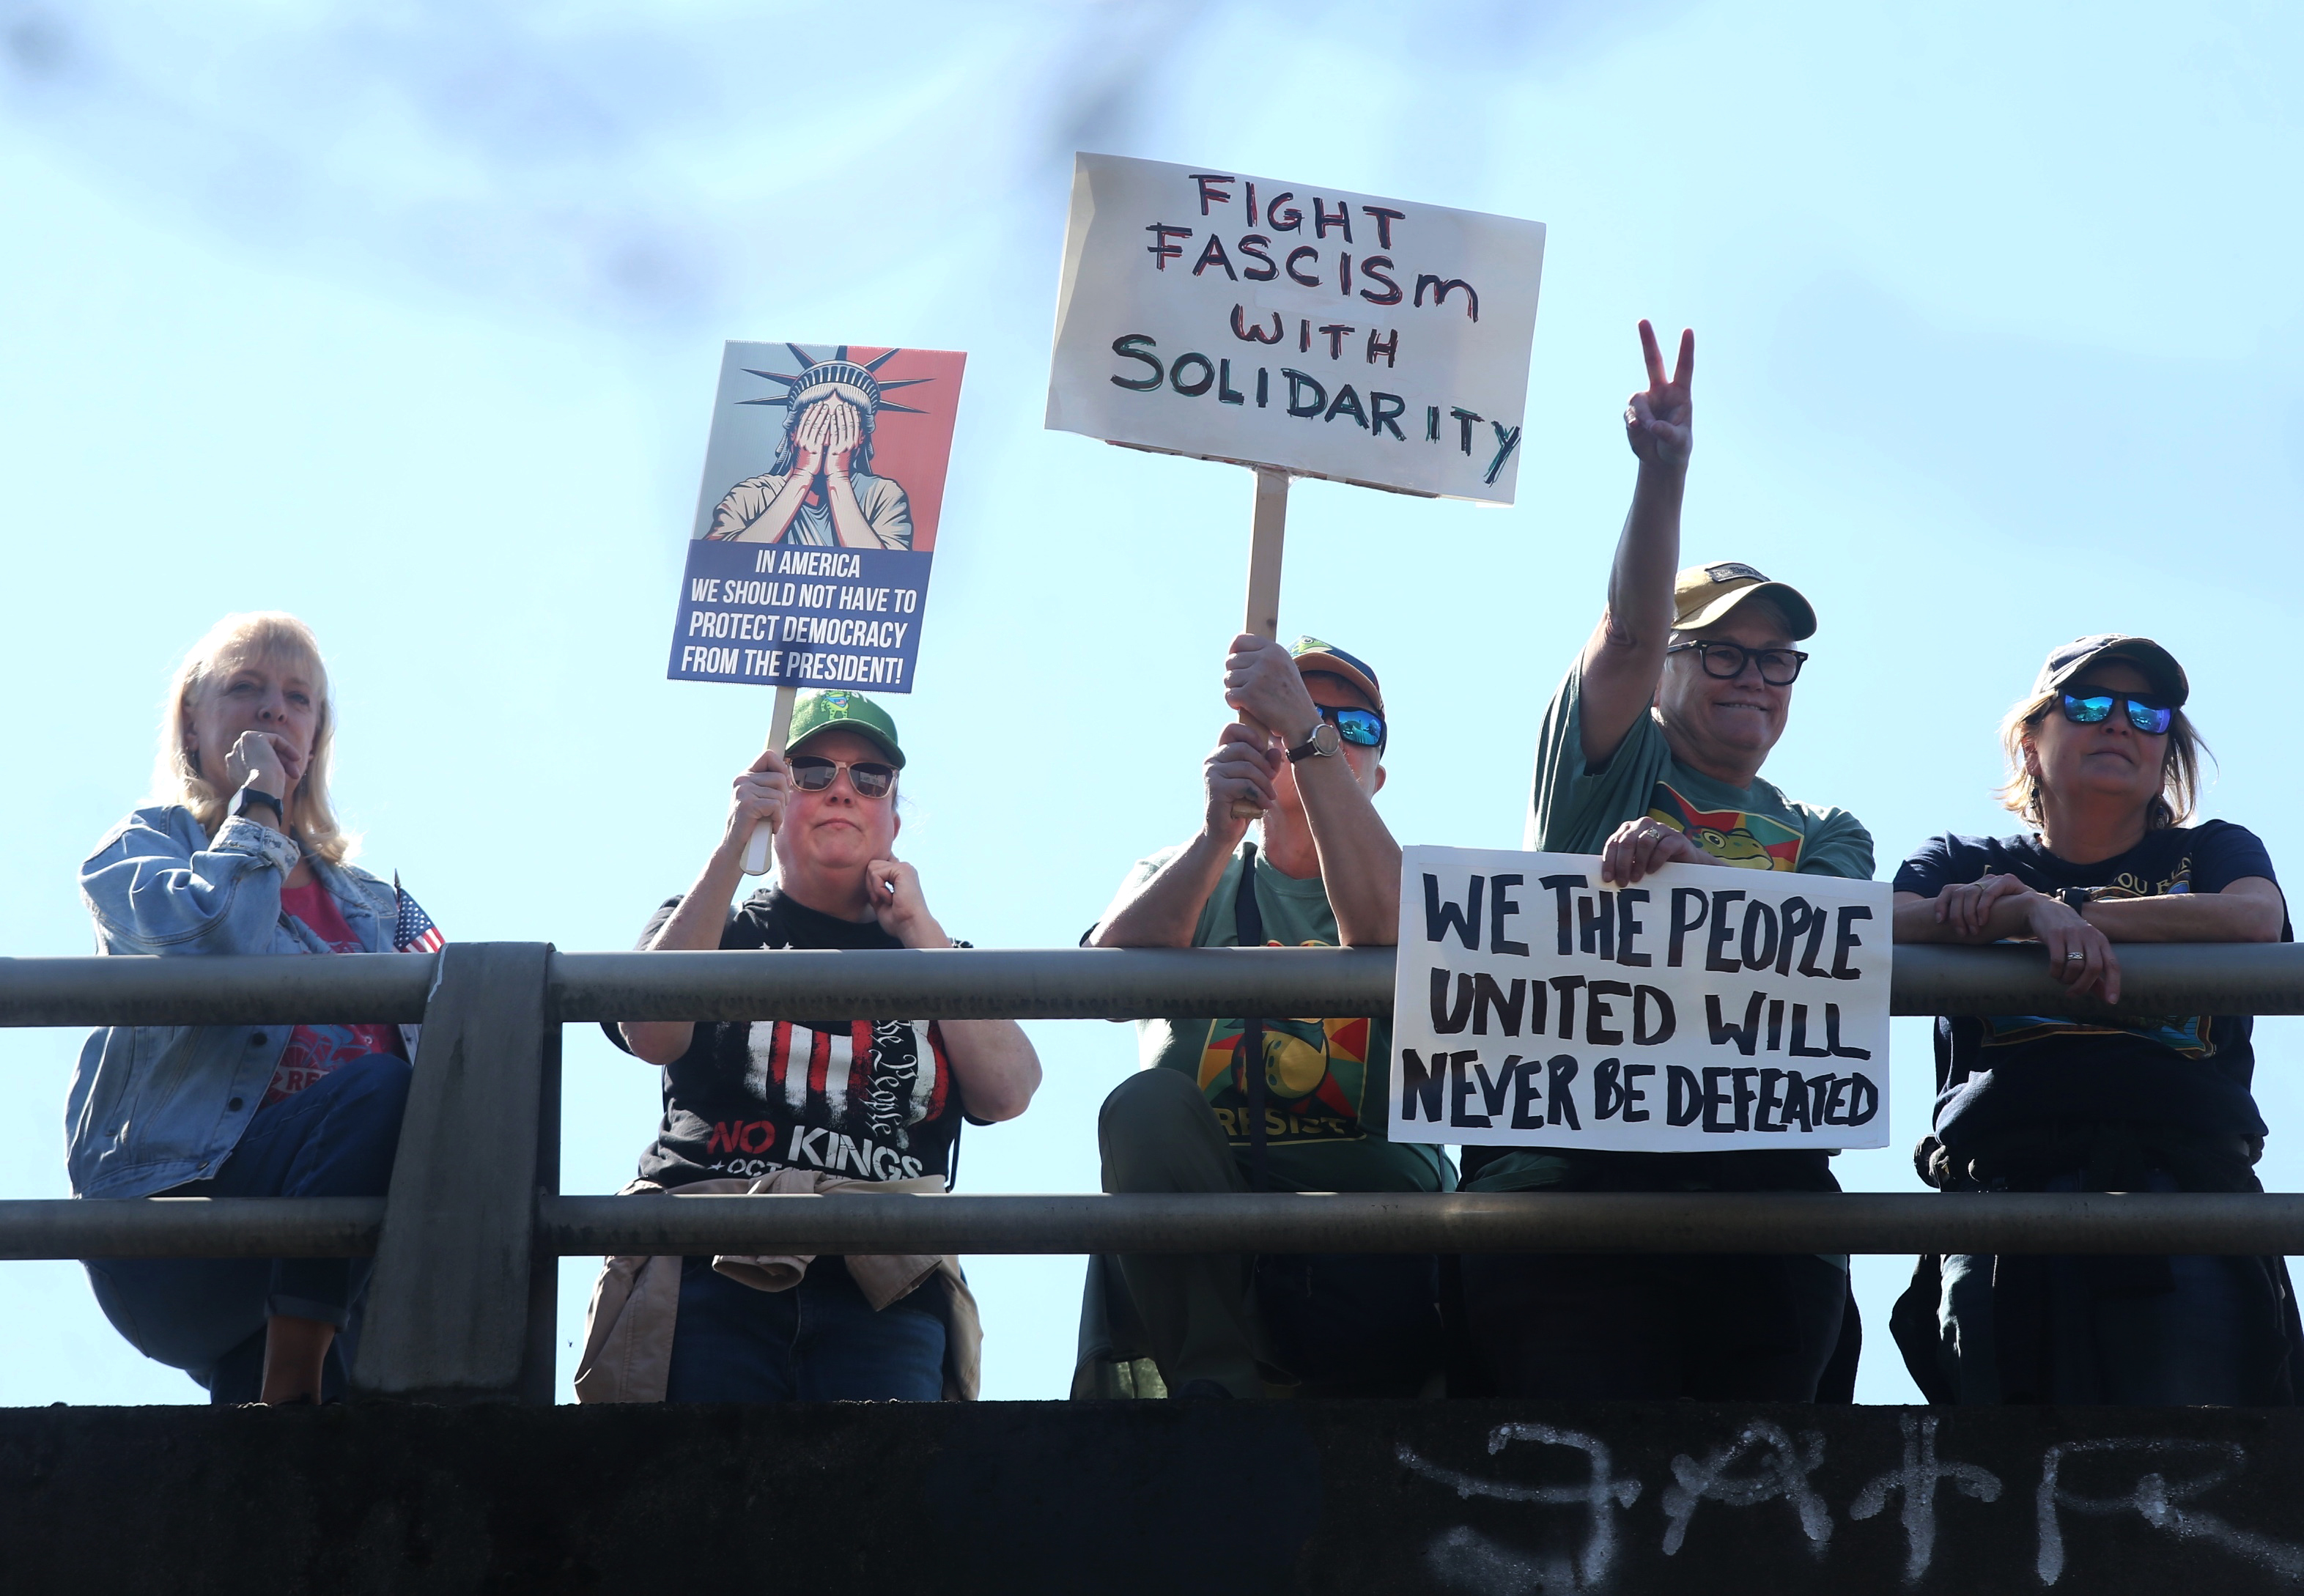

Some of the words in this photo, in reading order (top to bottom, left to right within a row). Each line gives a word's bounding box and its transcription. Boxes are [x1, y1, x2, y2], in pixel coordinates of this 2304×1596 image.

[1189, 174, 1405, 250] FIGHT
[1230, 303, 1399, 368] WITH
[1111, 333, 1521, 487] SOLIDARITY
[755, 549, 775, 573] IN
[778, 550, 861, 578] AMERICA
[691, 578, 720, 603] WE
[723, 579, 796, 607] SHOULD
[798, 584, 837, 609] NOT
[839, 586, 890, 613] HAVE
[894, 589, 917, 613] TO
[688, 611, 780, 641] PROTECT
[782, 616, 908, 649] DEMOCRACY
[680, 646, 739, 674] FROM
[744, 649, 783, 677] THE
[786, 651, 904, 684] PRESIDENT!
[2111, 872, 2148, 894] OU
[1422, 873, 1529, 957] WE
[1539, 874, 1652, 967] THE
[1667, 887, 1872, 980] PEOPLE
[870, 1019, 912, 1048] he
[1430, 967, 1677, 1046] UNITED
[1705, 991, 1872, 1061] WILL
[1401, 1049, 1581, 1131] NEVER
[1595, 1058, 1655, 1123] BE
[1666, 1065, 1878, 1133] DEFEATED
[707, 1120, 775, 1154] NO
[788, 1125, 923, 1181] KINGS
